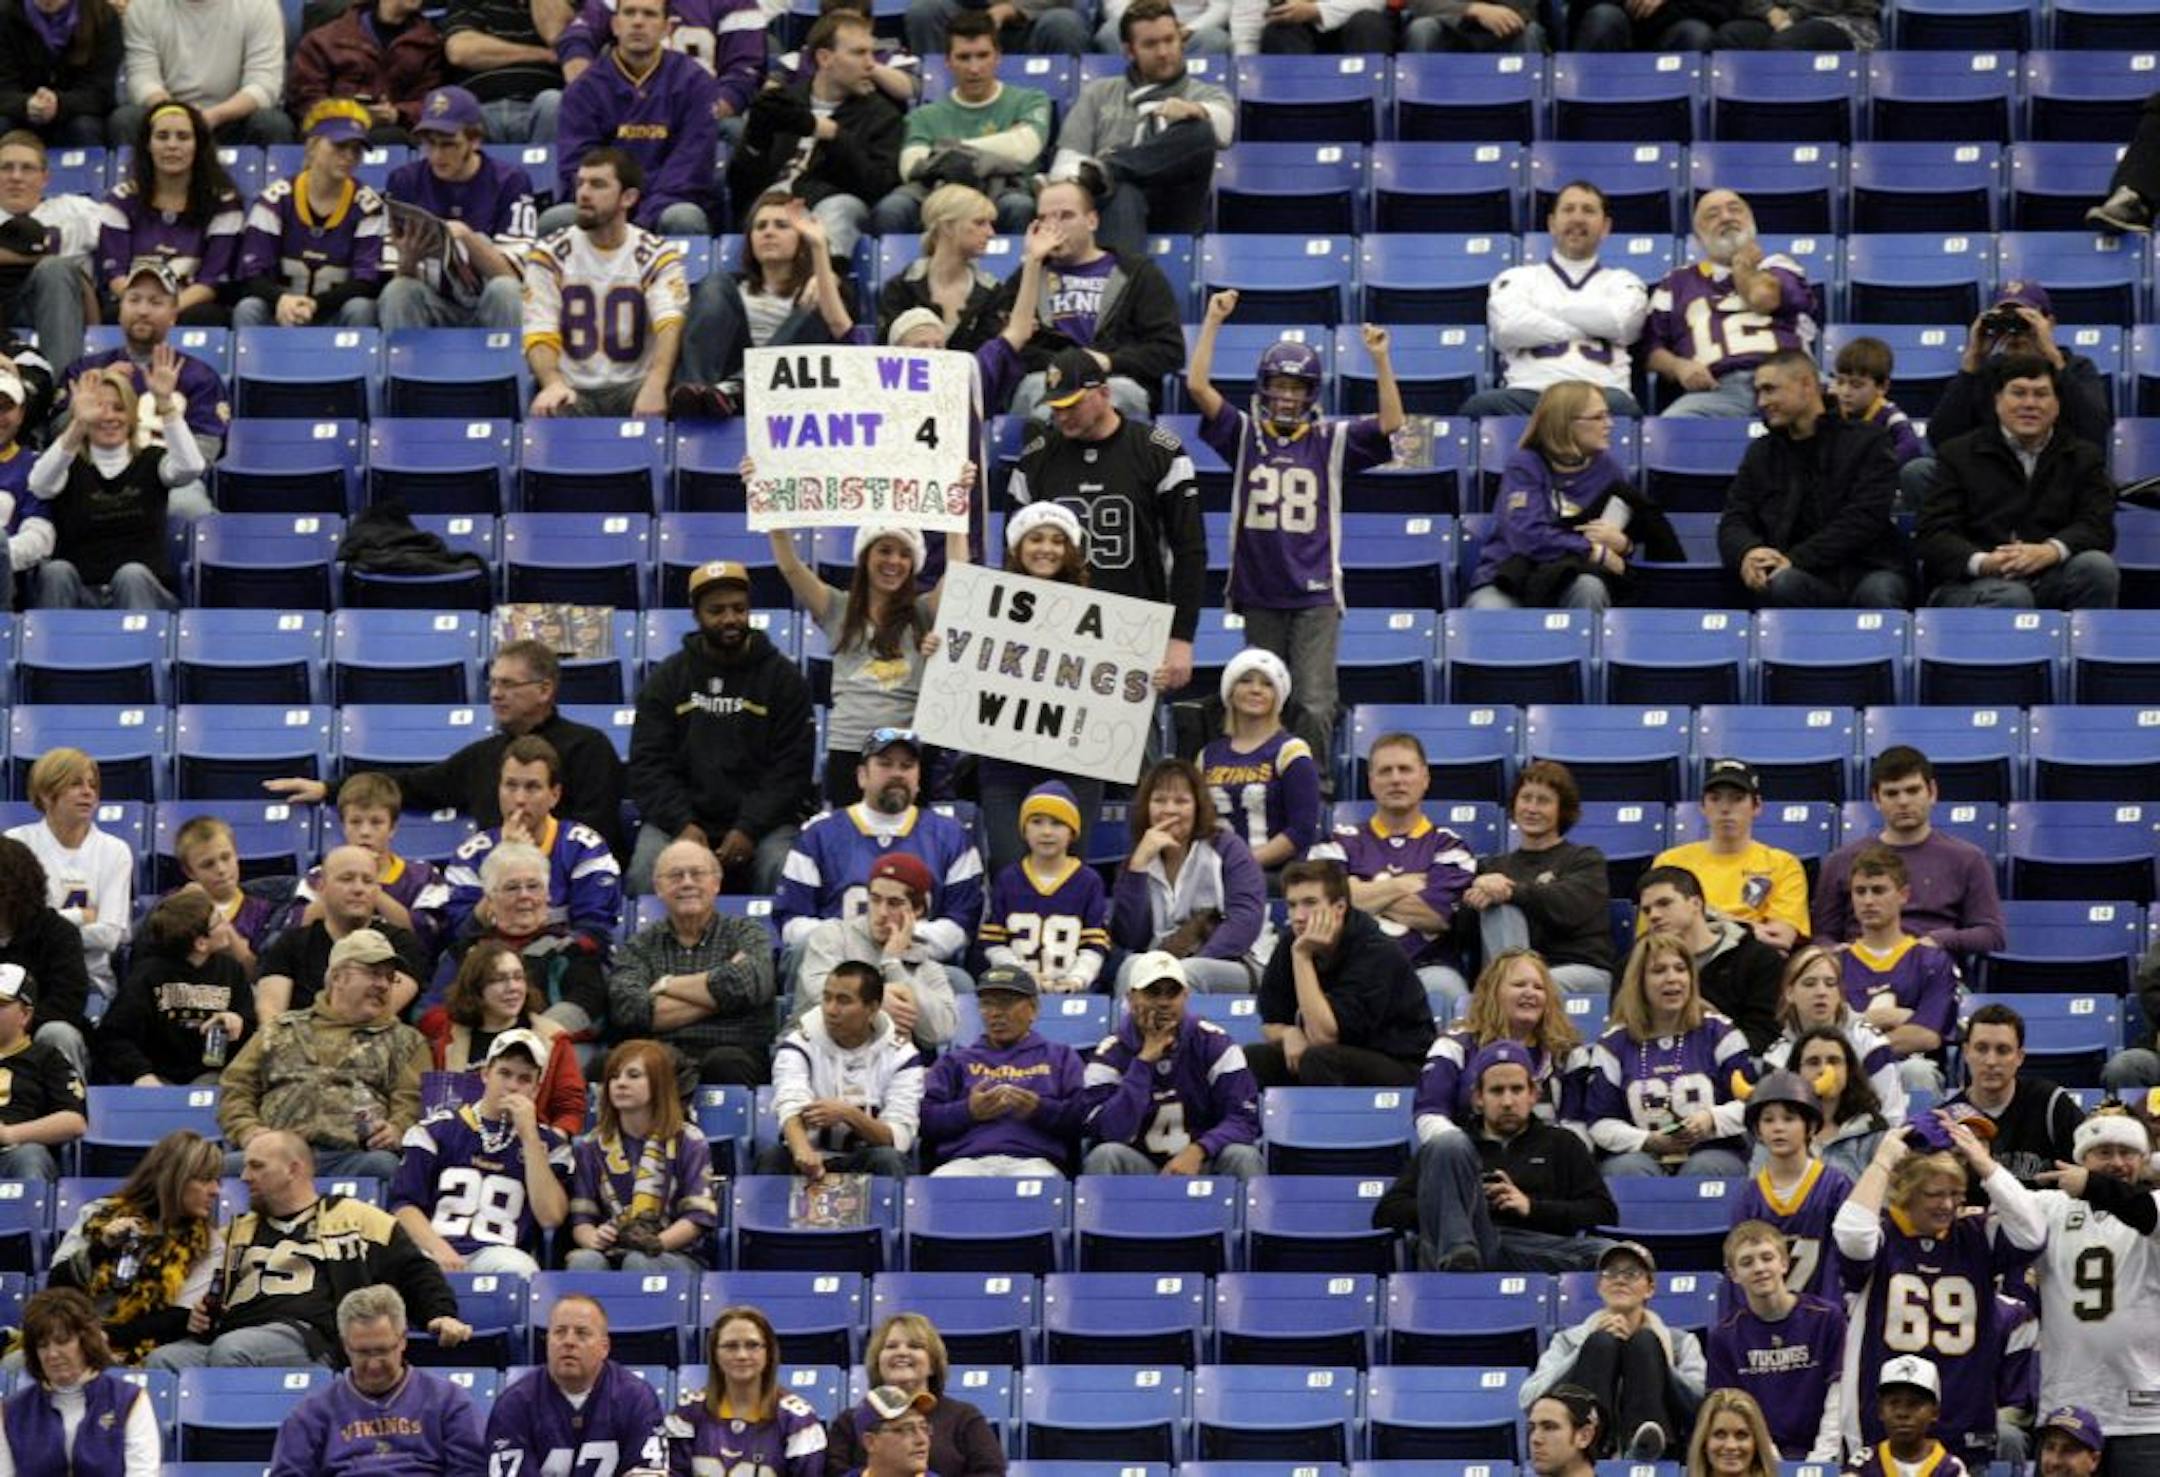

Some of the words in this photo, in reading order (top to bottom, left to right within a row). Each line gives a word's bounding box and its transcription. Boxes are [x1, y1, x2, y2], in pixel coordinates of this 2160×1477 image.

[560, 285, 649, 361] 80
[1686, 294, 1779, 368] 12
[769, 356, 841, 391] ALL
[876, 356, 931, 392] WE
[766, 412, 884, 449] WANT
[915, 416, 940, 450] 4
[749, 475, 970, 517] CHRISTMAS
[1244, 465, 1312, 528] 28
[988, 584, 1037, 624] IS
[1074, 603, 1104, 641] A
[945, 627, 1149, 704] VIKINGS
[976, 690, 1088, 748] WIN!
[1006, 911, 1081, 973] 28
[1143, 1101, 1191, 1157] 4
[432, 1167, 527, 1246] 28
[1883, 1272, 1978, 1355] 69
[2073, 1246, 2115, 1322] 9
[1747, 1344, 1809, 1368] VIKINGS
